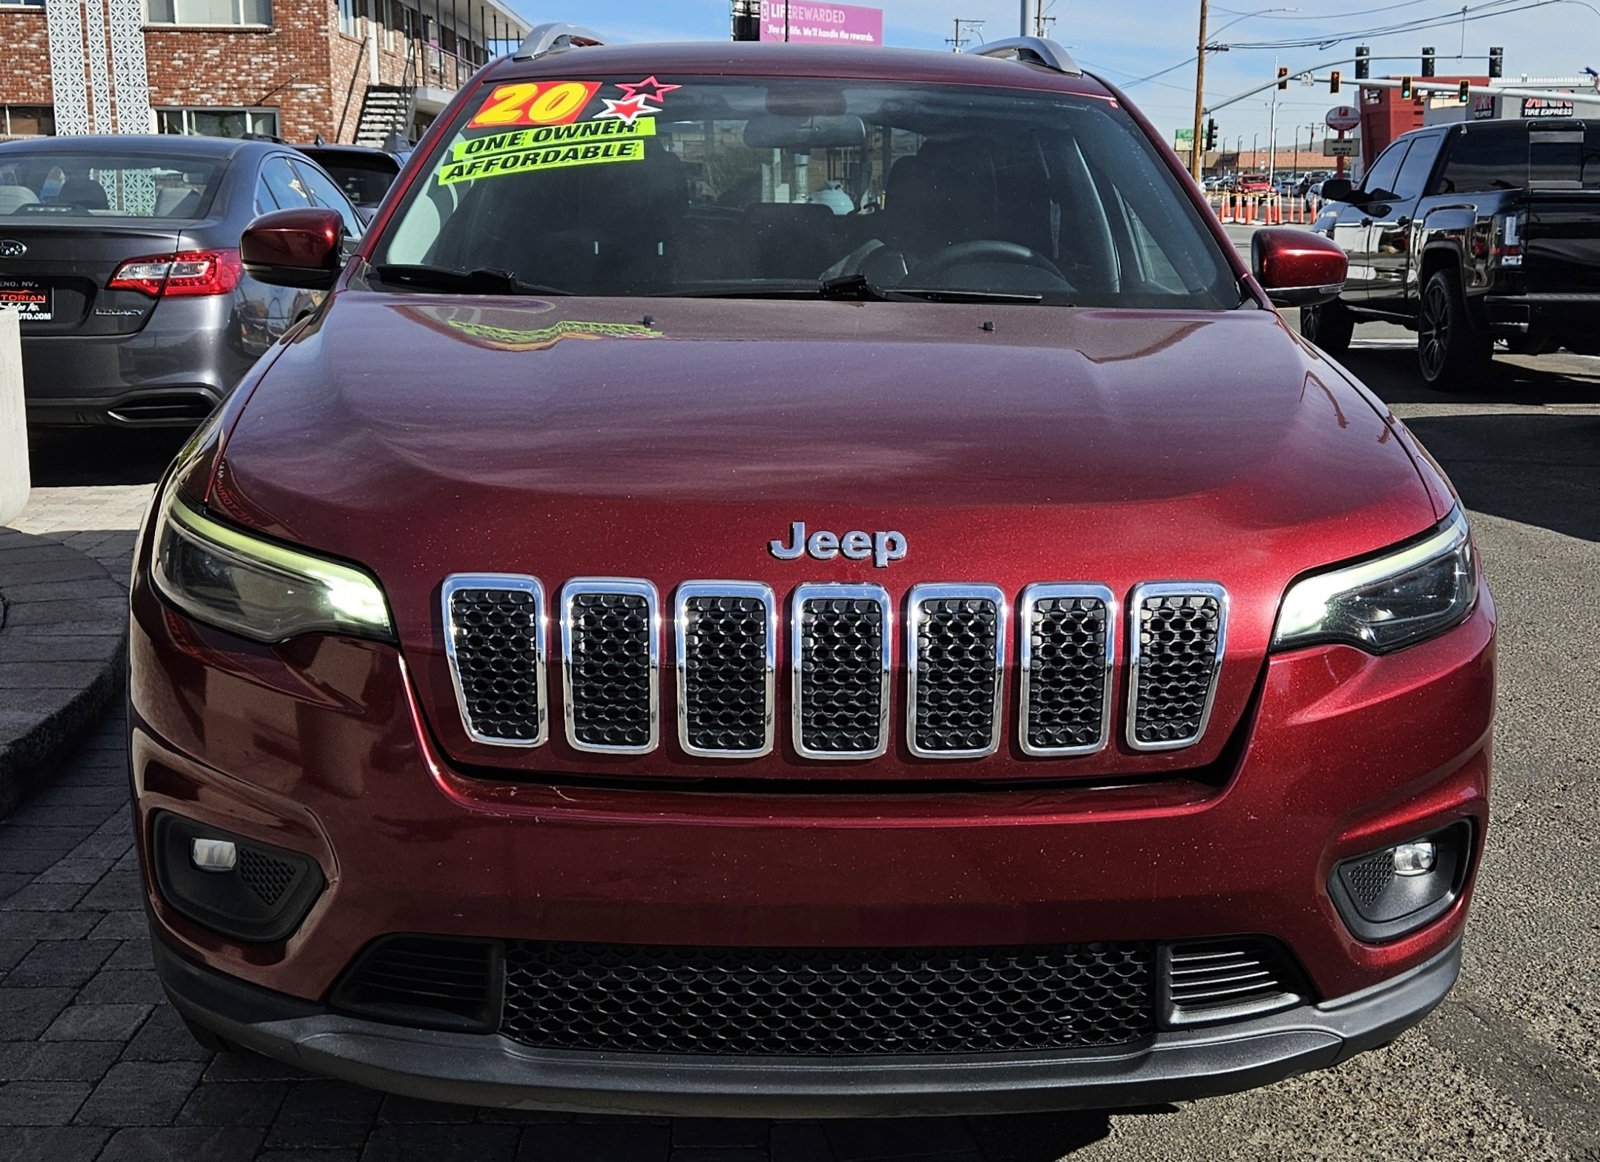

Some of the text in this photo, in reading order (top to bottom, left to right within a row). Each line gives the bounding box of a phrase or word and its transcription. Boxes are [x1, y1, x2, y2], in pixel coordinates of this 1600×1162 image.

[839, 30, 849, 39] the
[474, 83, 588, 124] 20
[464, 119, 639, 155] ONE OWNER
[443, 141, 639, 180] AFFORDABLE
[768, 521, 907, 568] Jeep
